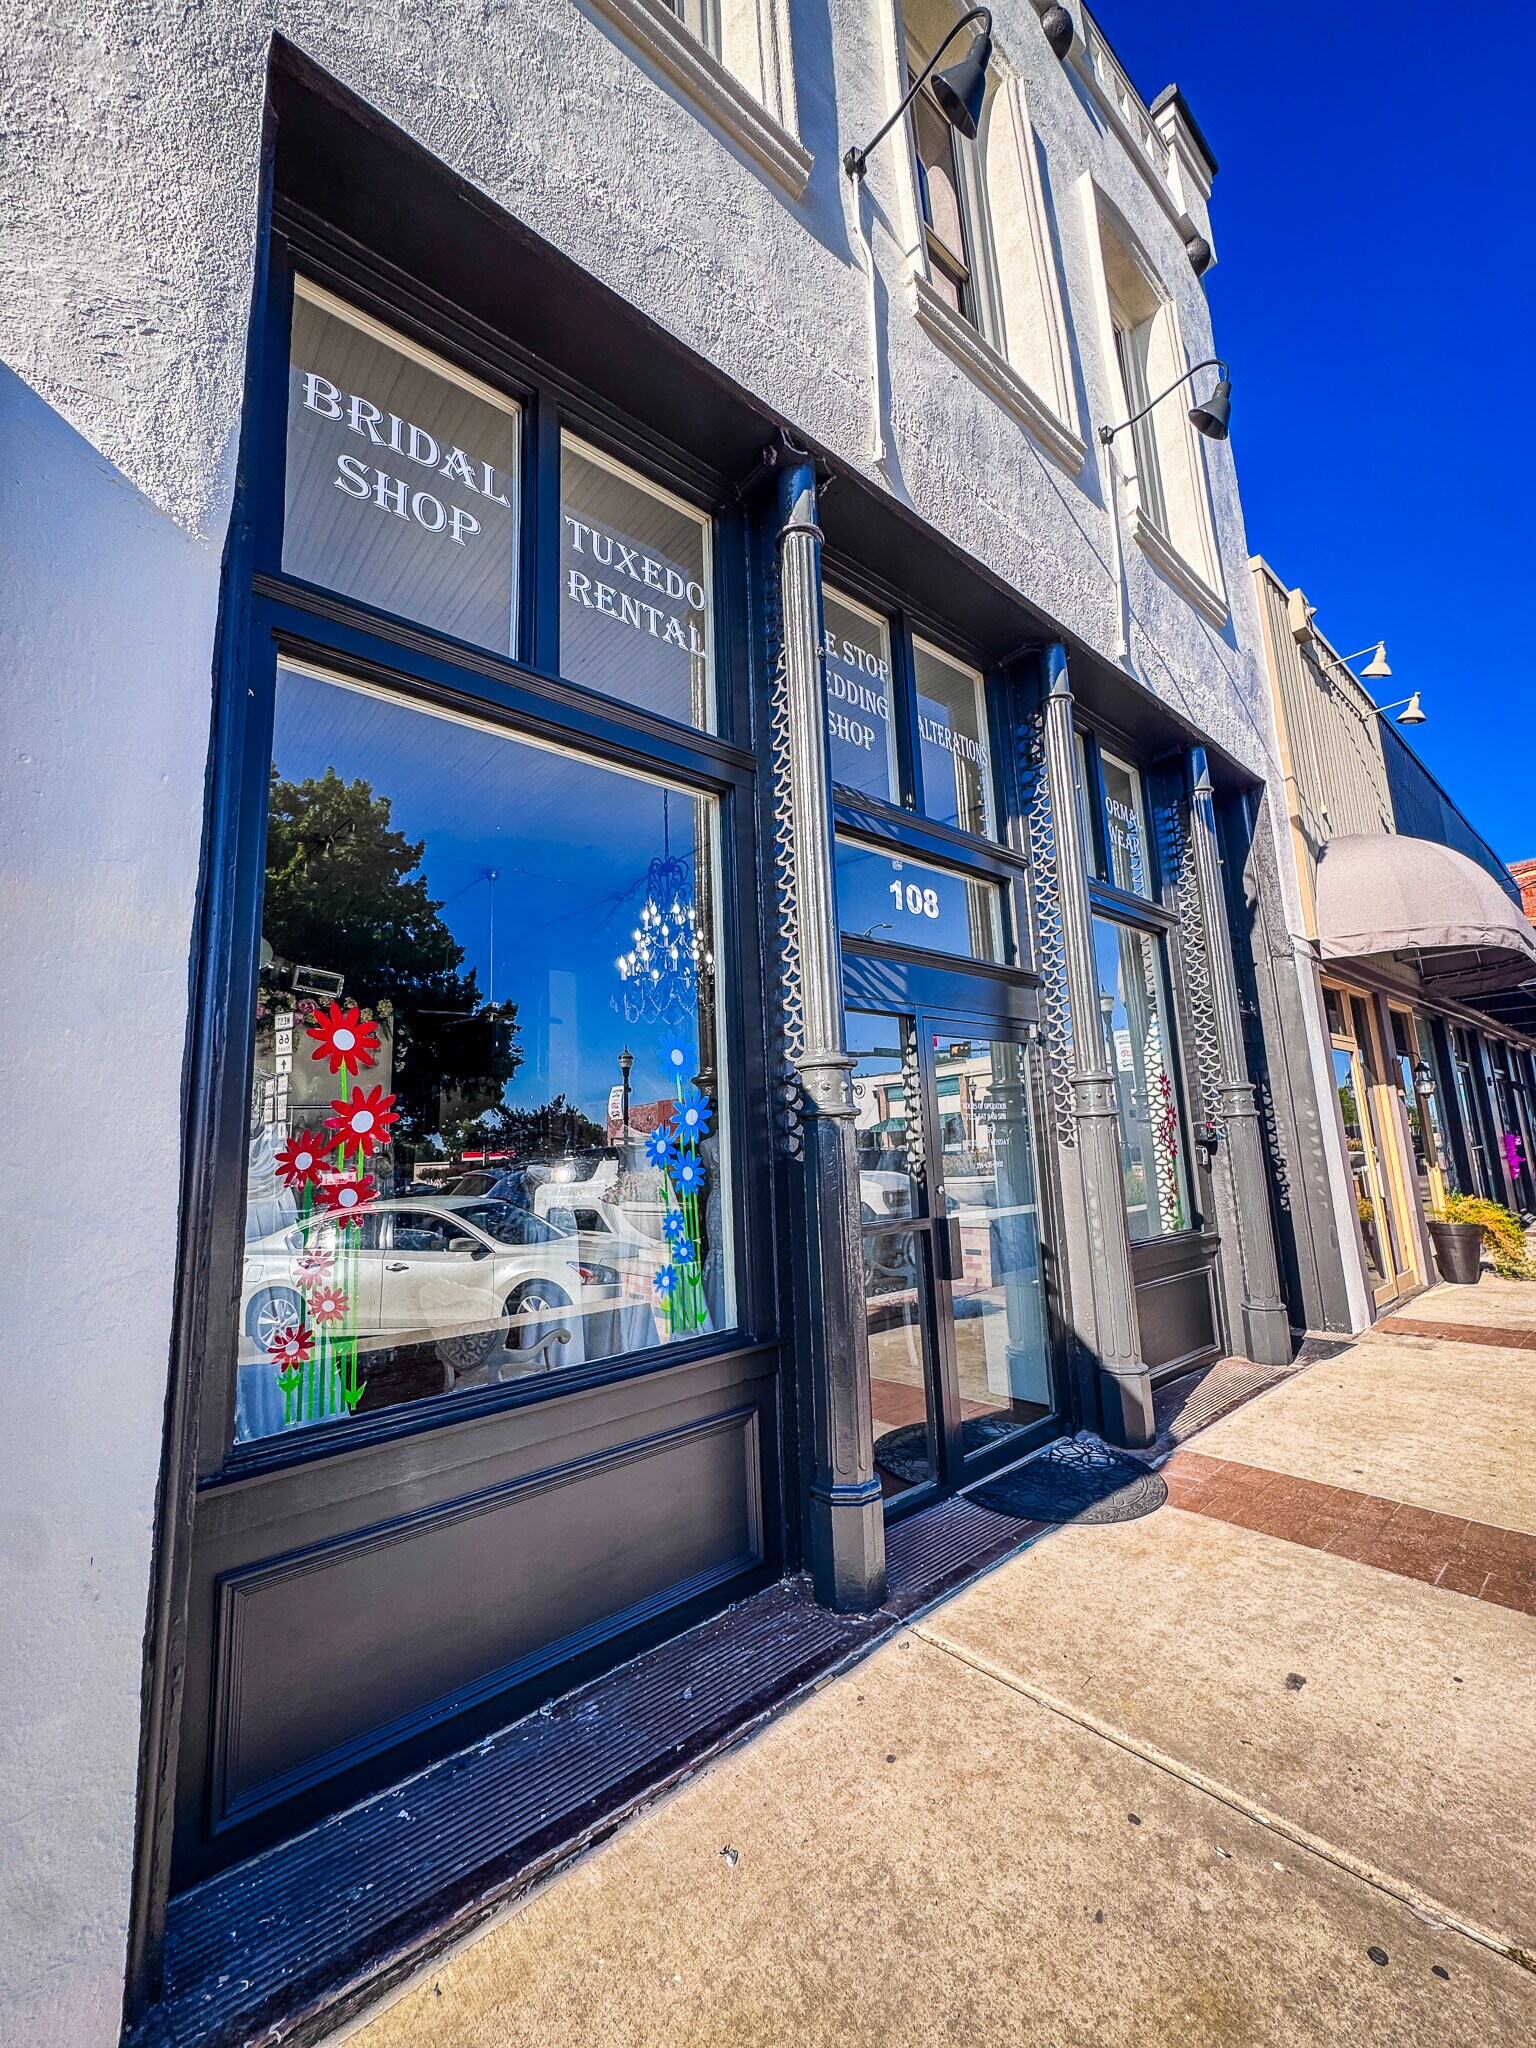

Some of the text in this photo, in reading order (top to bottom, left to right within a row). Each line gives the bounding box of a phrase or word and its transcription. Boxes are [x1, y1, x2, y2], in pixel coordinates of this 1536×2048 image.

[302, 372, 510, 508] BRIDAL
[334, 454, 481, 546] SHOP
[564, 515, 706, 611] TUXEDO
[567, 570, 706, 659] RENTAL
[842, 640, 889, 683] STOP
[826, 670, 890, 721] EDDING
[828, 710, 875, 751] SHOP
[918, 714, 988, 767] ALTERATIONS
[1105, 796, 1144, 830] ORMAL
[1108, 822, 1141, 856] WEAR
[889, 879, 940, 919] 108
